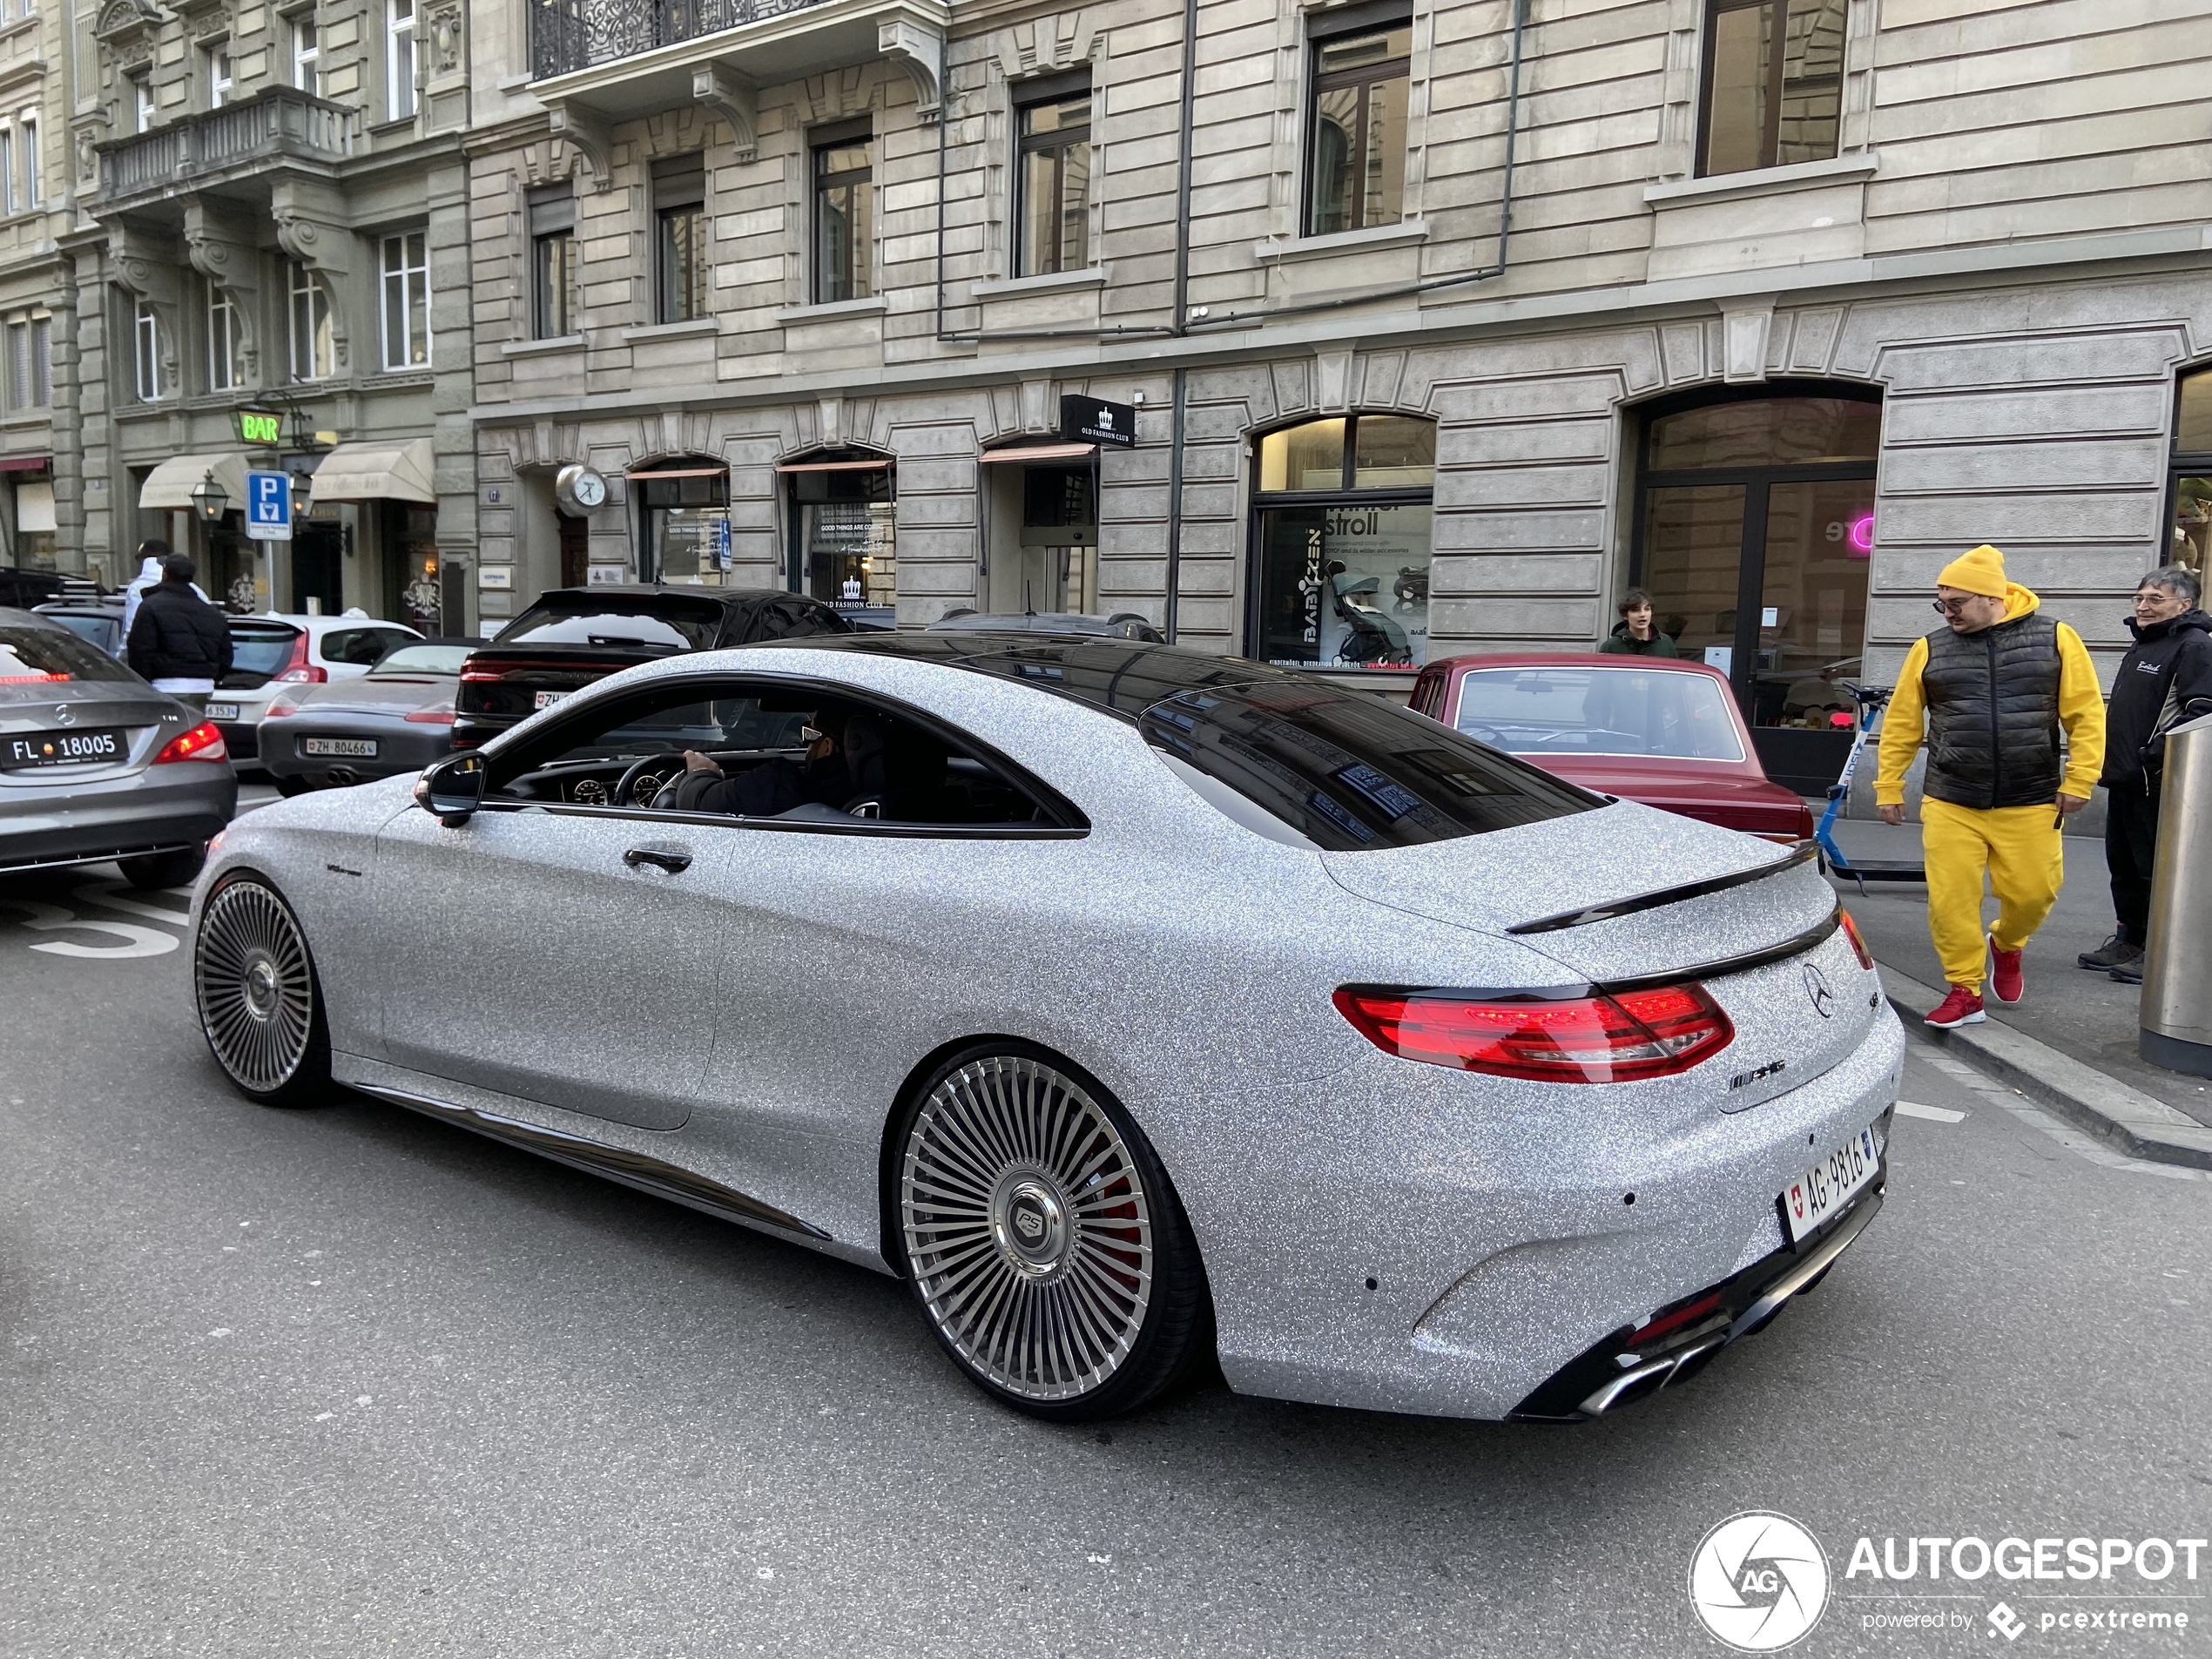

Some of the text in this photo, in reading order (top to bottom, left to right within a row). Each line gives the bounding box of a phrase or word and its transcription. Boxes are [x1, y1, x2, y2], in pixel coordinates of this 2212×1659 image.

[243, 415, 278, 442] BAR
[1093, 429, 1115, 439] FASHION
[260, 477, 278, 502] P
[1325, 511, 1378, 536] stroll
[12, 734, 116, 760] FL 18005
[316, 741, 366, 754] ZH 80466
[1806, 1136, 1864, 1217] AG 9816
[1018, 1213, 1042, 1229] PS
